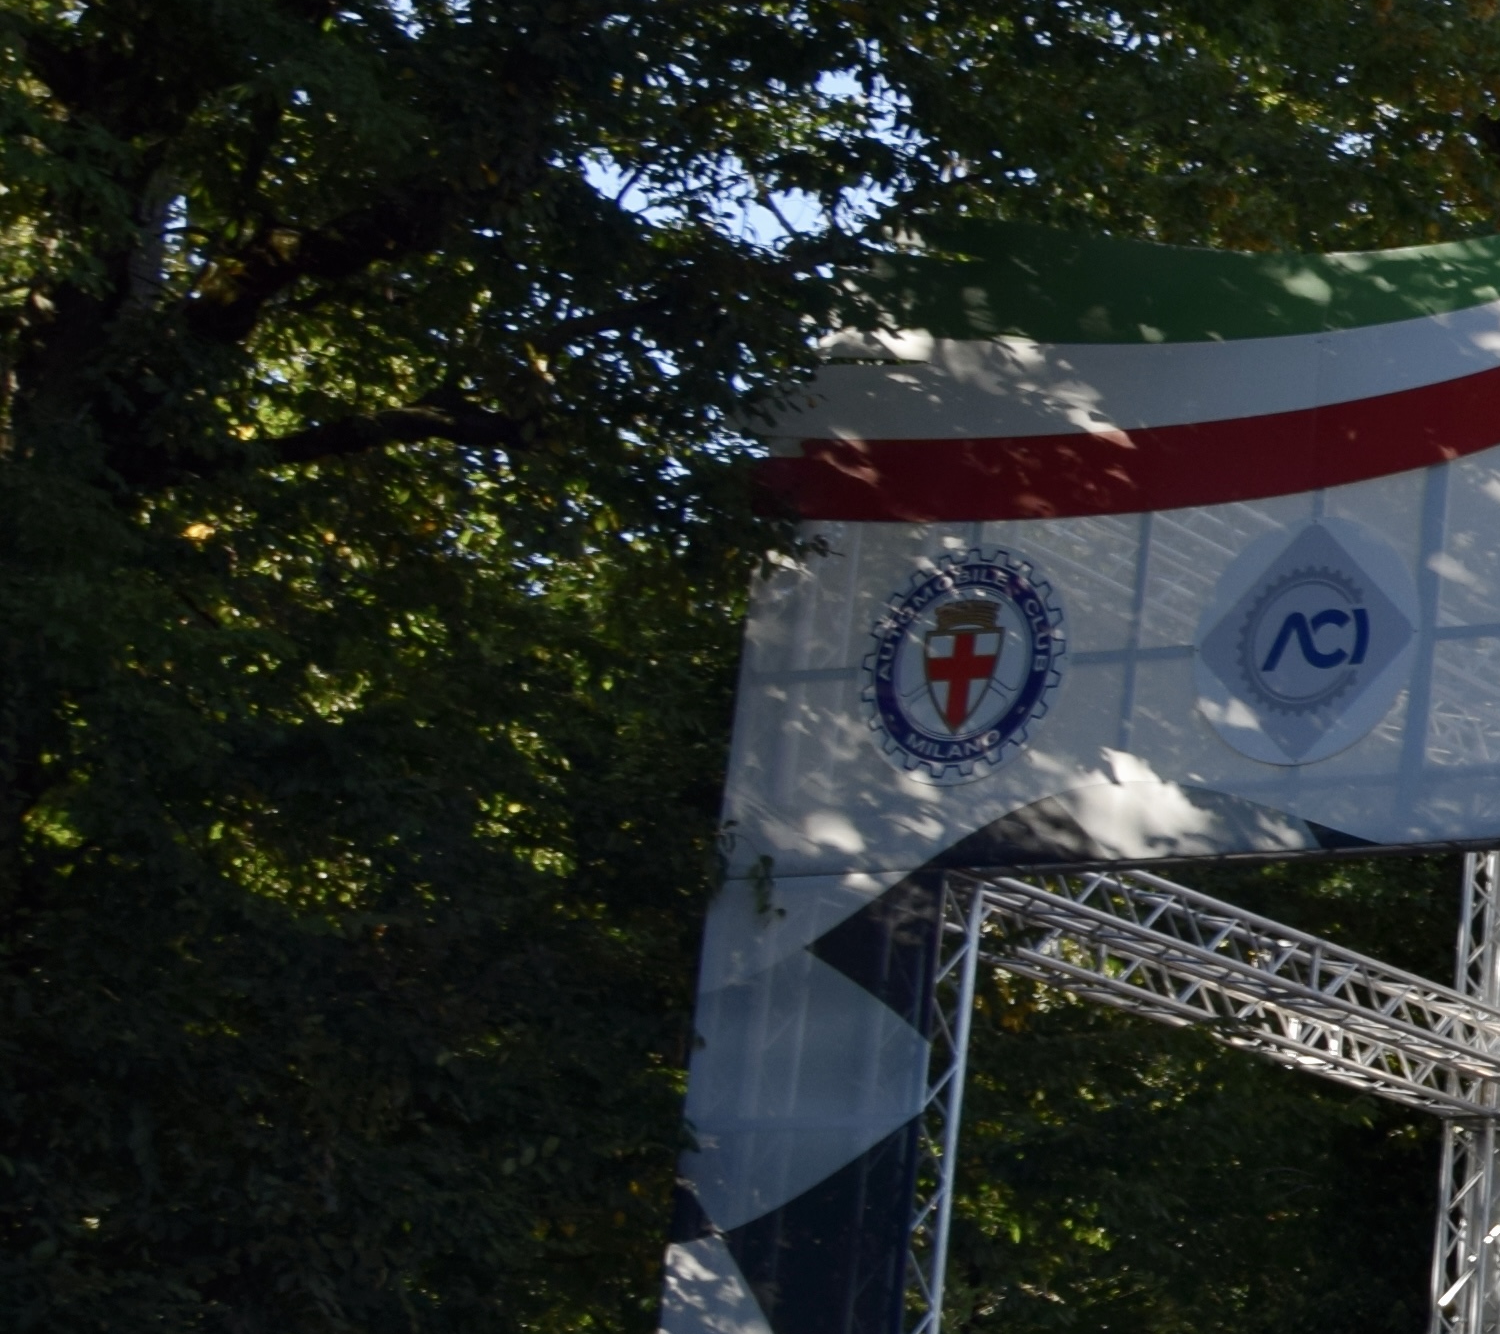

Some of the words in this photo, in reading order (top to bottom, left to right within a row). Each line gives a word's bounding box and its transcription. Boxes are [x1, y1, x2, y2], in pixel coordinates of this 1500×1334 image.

[878, 569, 1009, 681] AUTOMOBILE
[1023, 597, 1050, 672] CLUB
[1262, 609, 1369, 671] ACI
[905, 729, 1000, 759] MILANO
